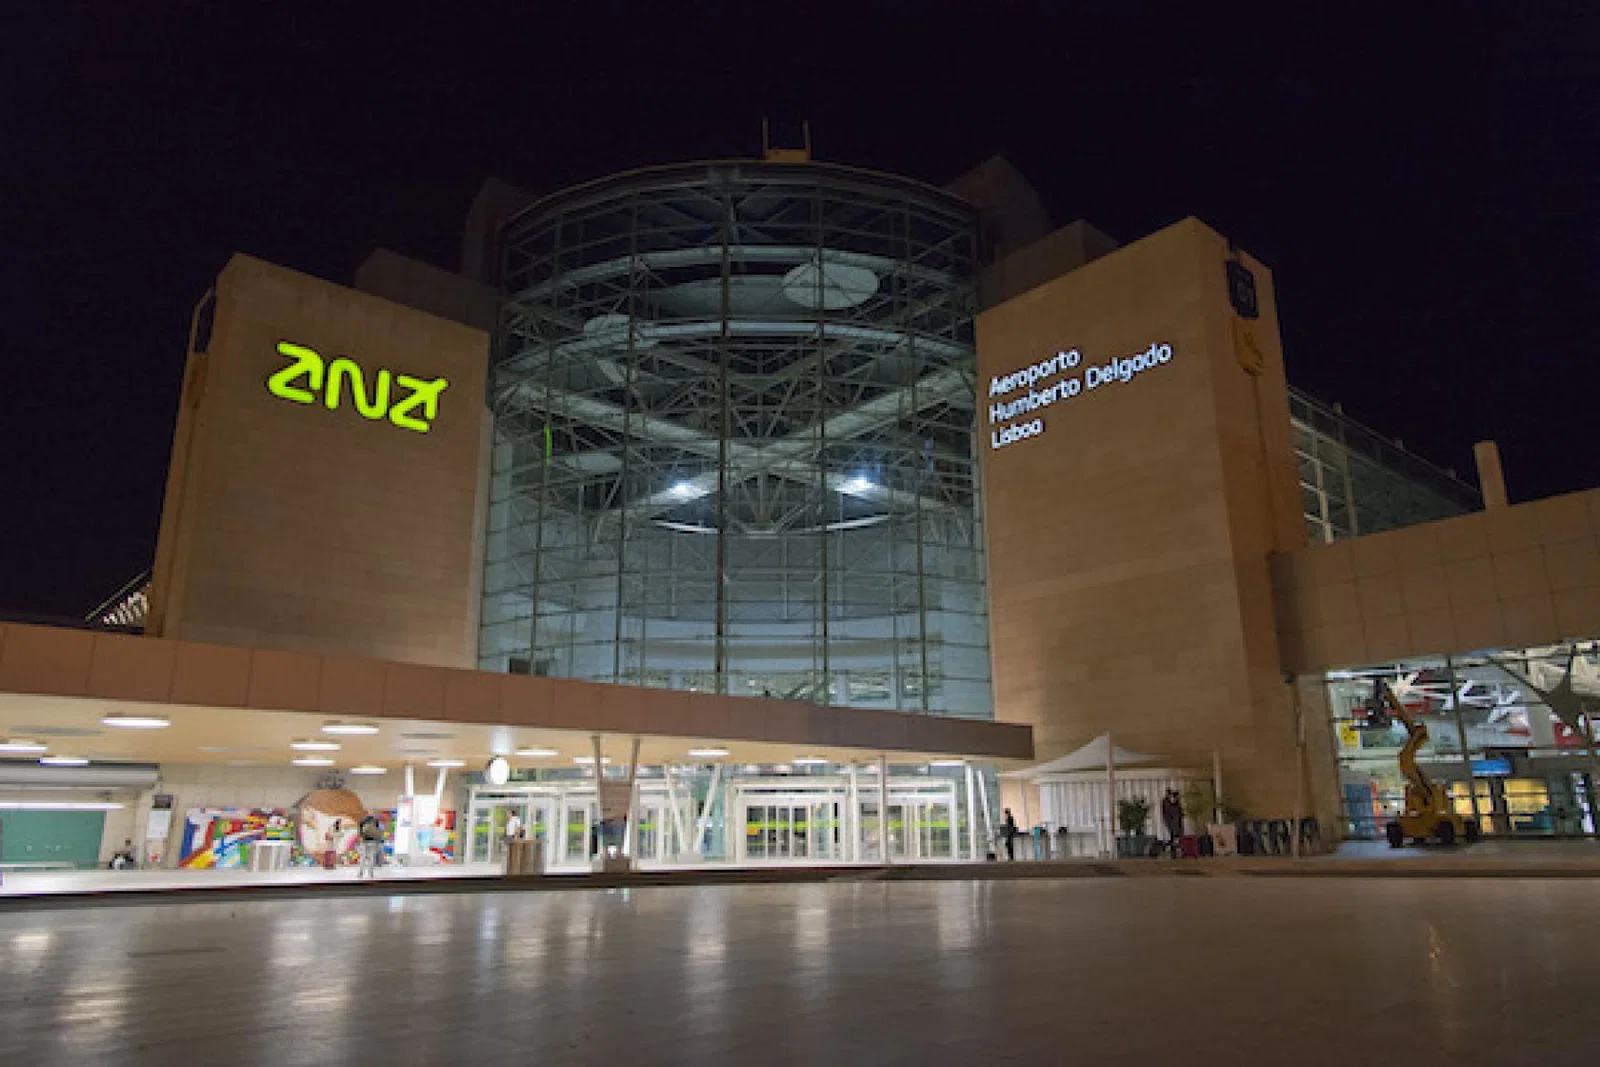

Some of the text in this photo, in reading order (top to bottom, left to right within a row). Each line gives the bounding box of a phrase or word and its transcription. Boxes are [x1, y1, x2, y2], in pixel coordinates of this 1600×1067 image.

[989, 349, 1081, 398] Aeroporto
[989, 343, 1173, 424] Humberto Delgado
[991, 418, 1044, 449] Lisboa
